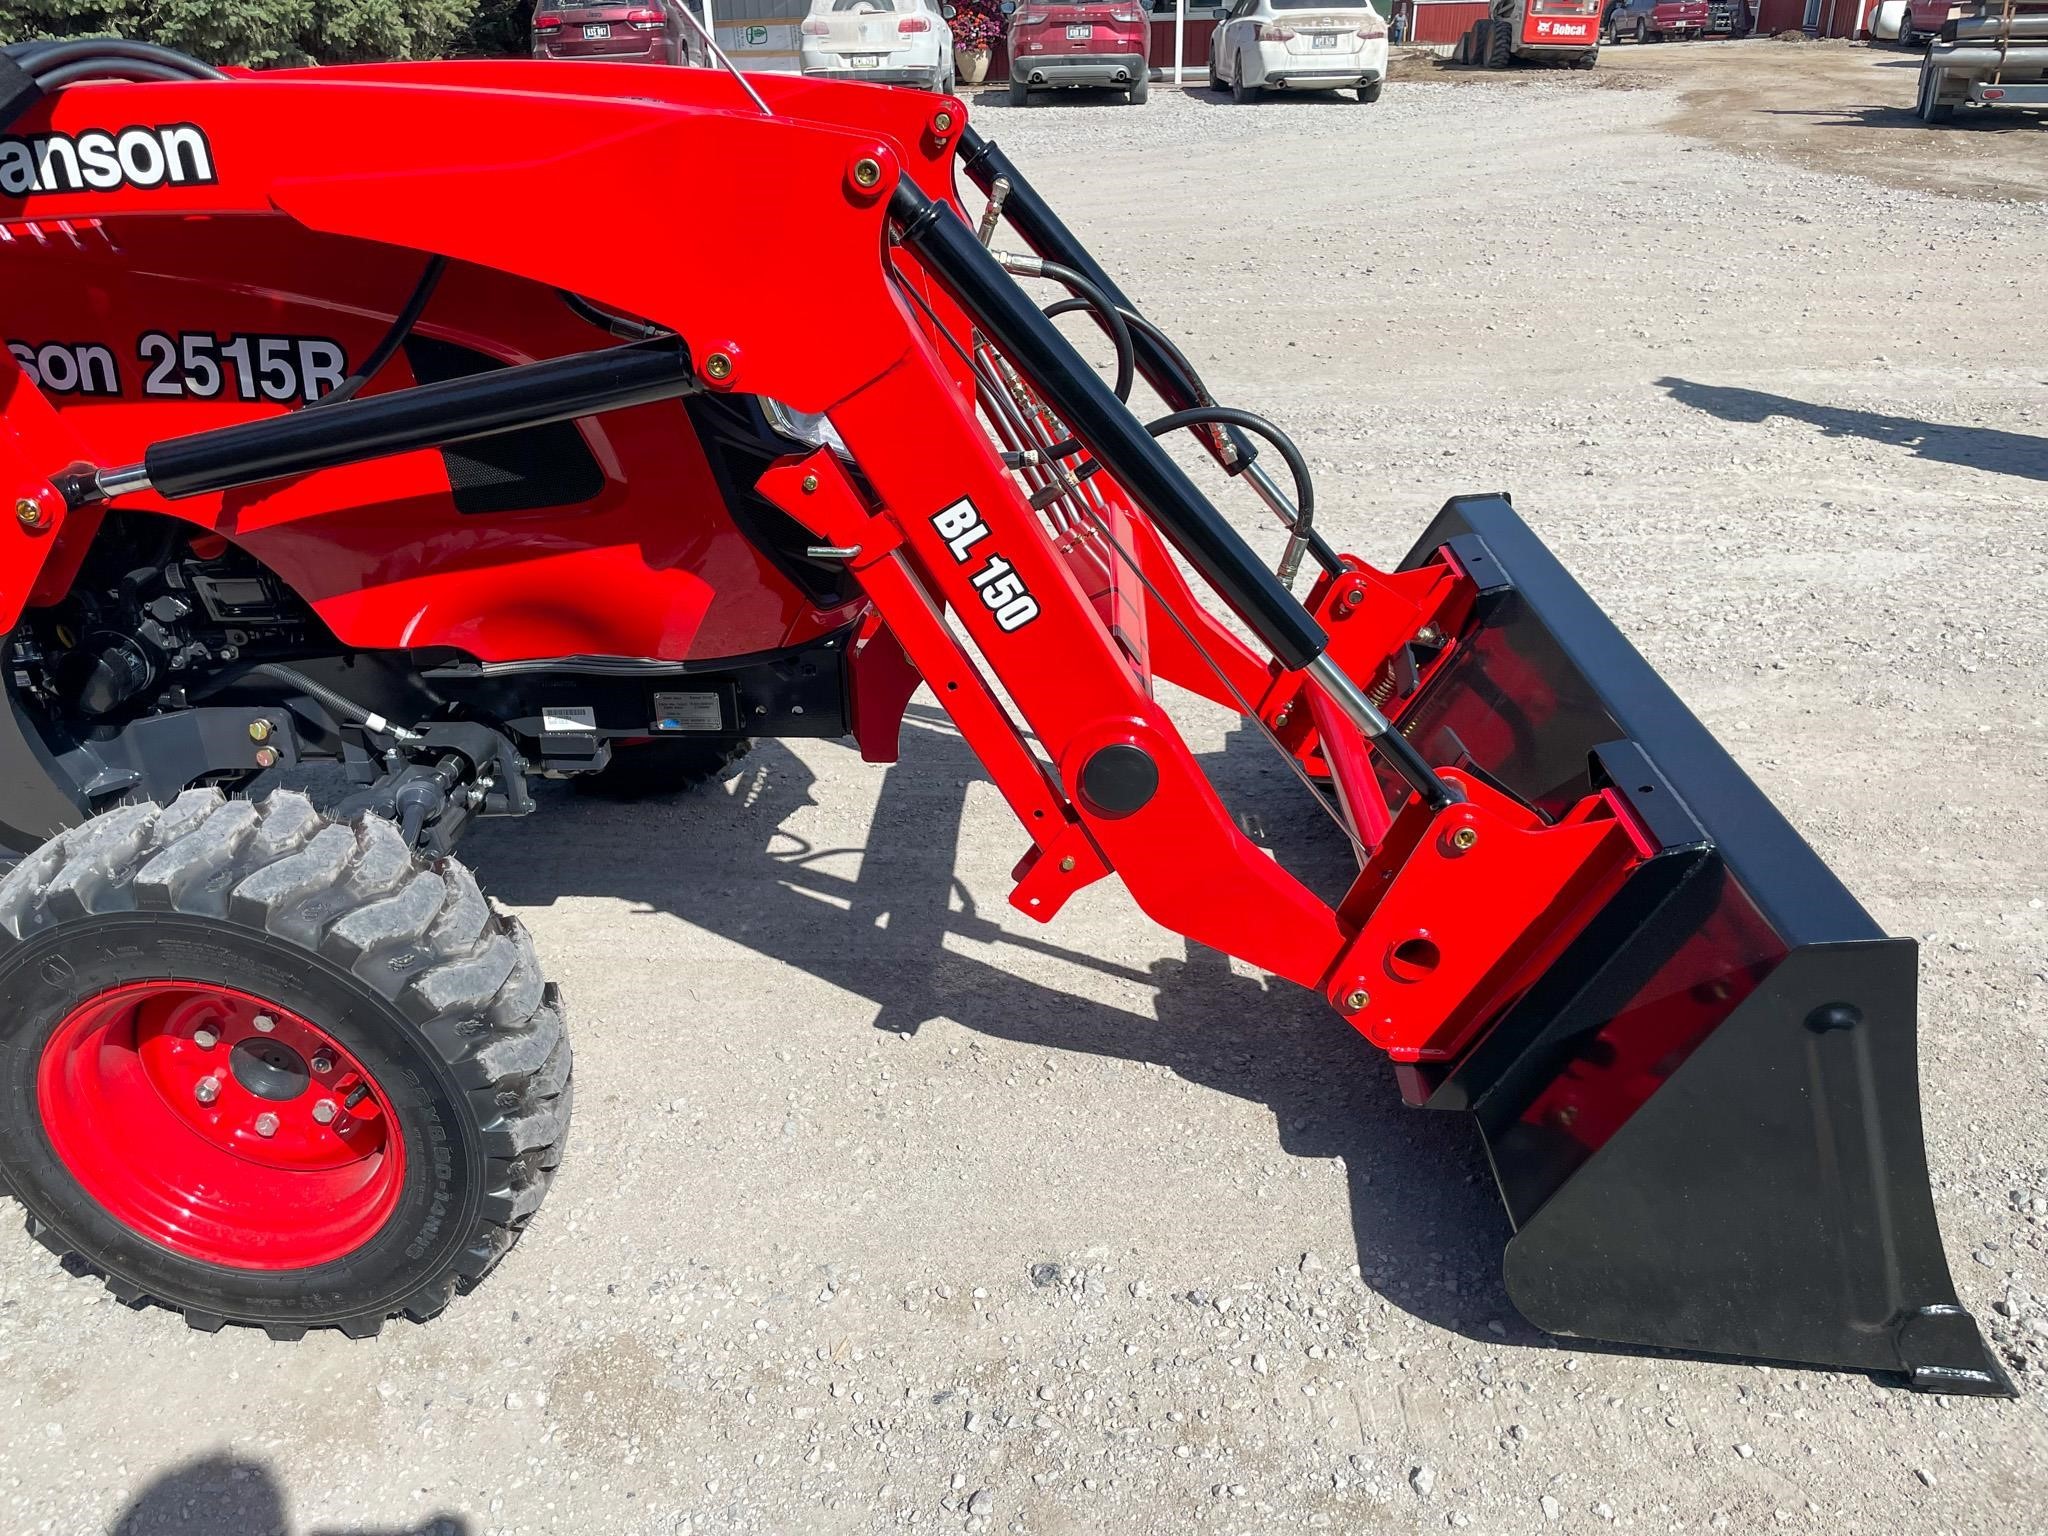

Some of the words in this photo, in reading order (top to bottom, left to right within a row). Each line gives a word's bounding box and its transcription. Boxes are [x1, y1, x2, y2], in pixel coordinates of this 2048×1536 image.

[1552, 23, 1587, 36] Bobcat
[0, 126, 213, 191] anson
[140, 334, 345, 401] 2515R
[931, 496, 990, 564] BL
[970, 554, 1039, 632] 150
